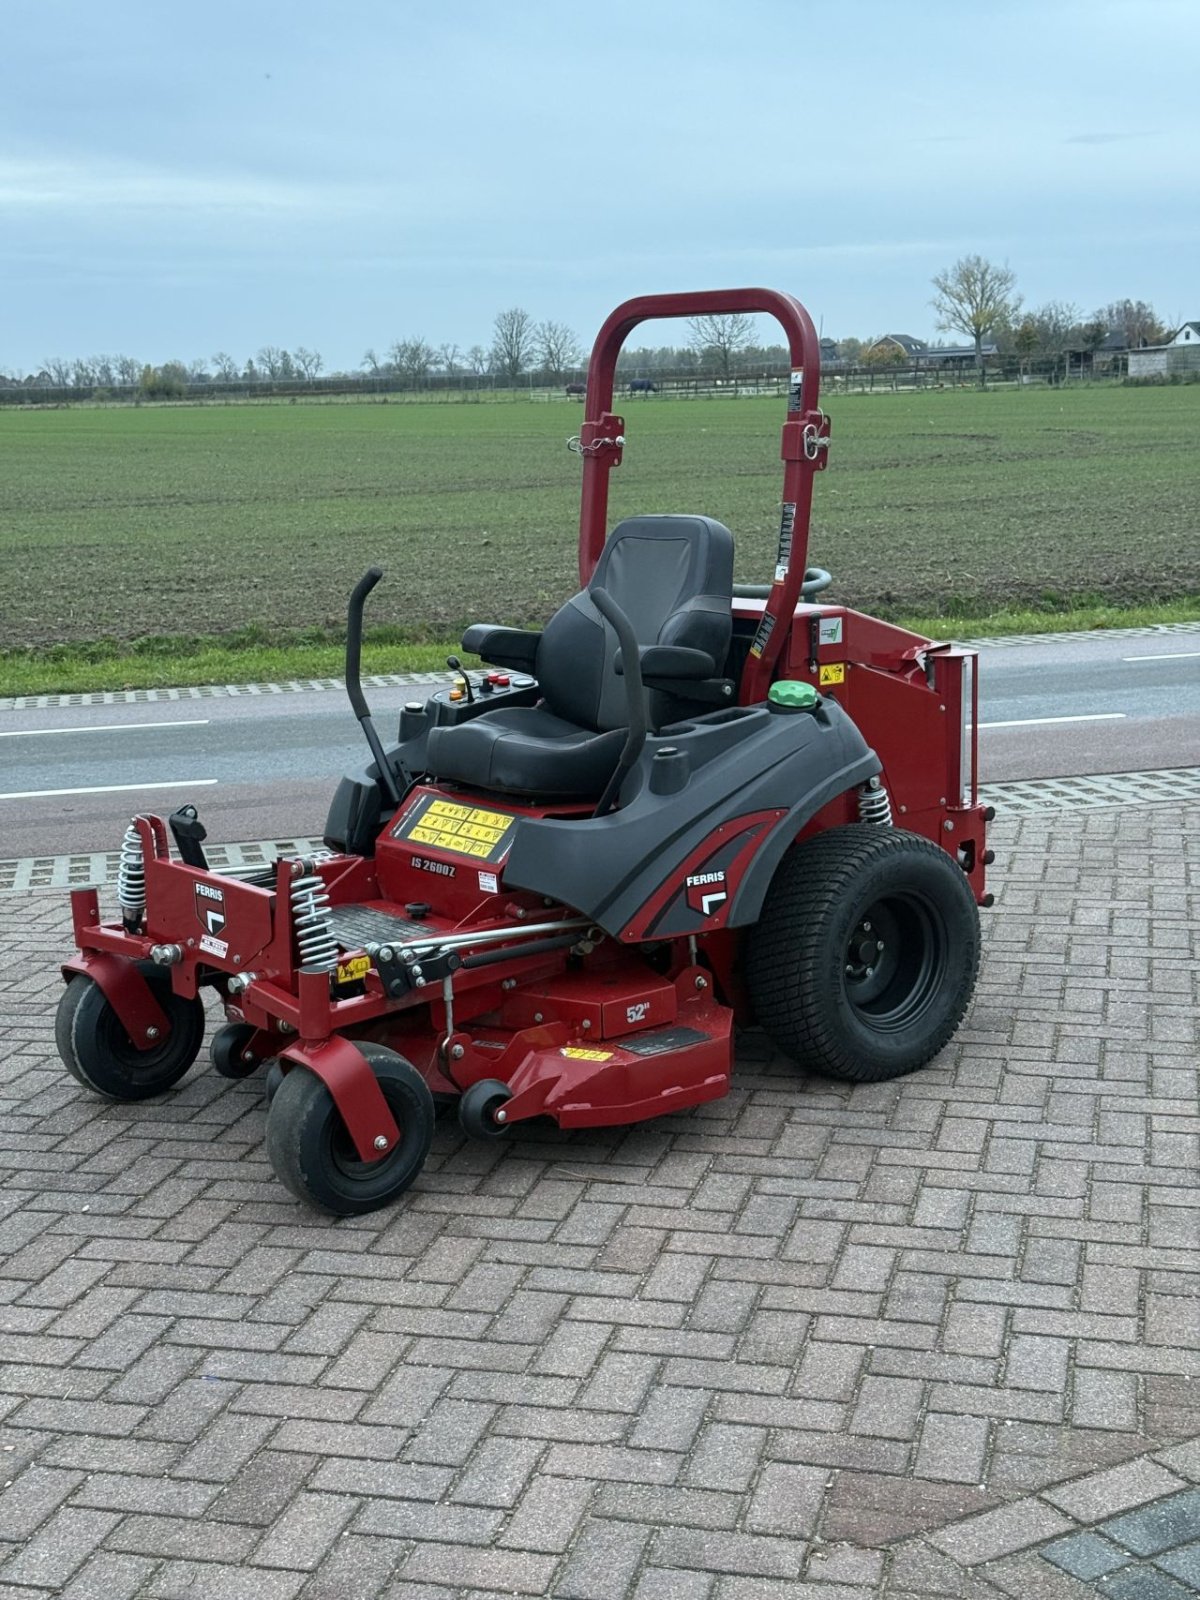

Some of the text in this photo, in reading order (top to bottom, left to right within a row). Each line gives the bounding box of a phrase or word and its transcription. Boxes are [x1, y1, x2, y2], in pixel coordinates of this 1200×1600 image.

[411, 856, 456, 878] IS 2600Z
[686, 871, 725, 887] FERRIS
[195, 883, 223, 901] FERRIS
[626, 1002, 650, 1023] 52"
